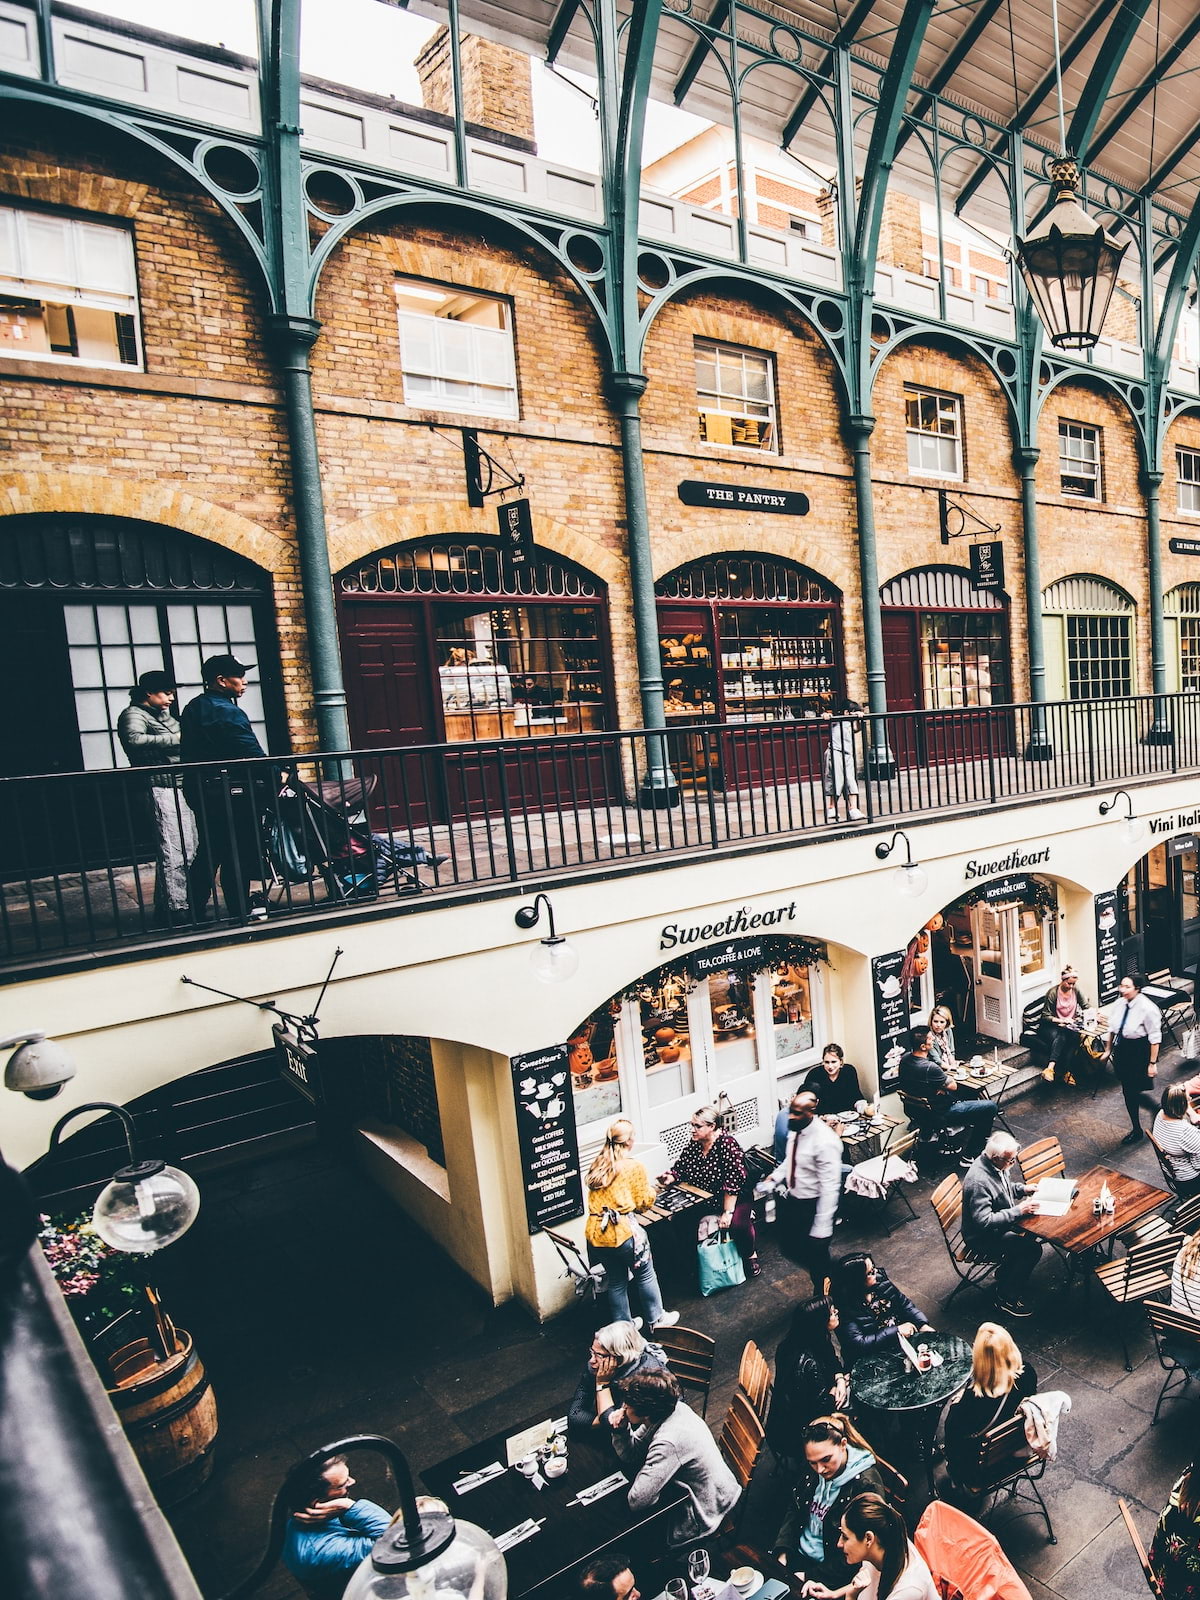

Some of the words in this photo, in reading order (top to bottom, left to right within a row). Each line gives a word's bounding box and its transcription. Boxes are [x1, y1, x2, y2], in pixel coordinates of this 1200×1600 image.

[706, 488, 734, 501] THE
[737, 491, 787, 507] PANTRY
[1149, 812, 1174, 834] Vini
[964, 846, 1051, 880] Sweetheart
[986, 888, 1001, 899] HOME
[1000, 885, 1013, 895] MADE
[1013, 881, 1027, 891] CAKES
[659, 901, 797, 951] Sweetheart
[697, 952, 737, 970] TEA,COFFEE
[737, 951, 743, 960] &
[743, 946, 761, 960] LOVE
[285, 1047, 308, 1083] Exit
[519, 1053, 562, 1071] Sweetheart
[532, 1133, 545, 1144] Great
[534, 1143, 547, 1154] MILK
[546, 1138, 564, 1150] SHAKES
[530, 1160, 541, 1170] HOT
[541, 1151, 571, 1167] CHOCOLATES
[537, 1168, 550, 1178] ICED
[543, 1192, 555, 1203] ICED
[554, 1188, 566, 1199] TEAS
